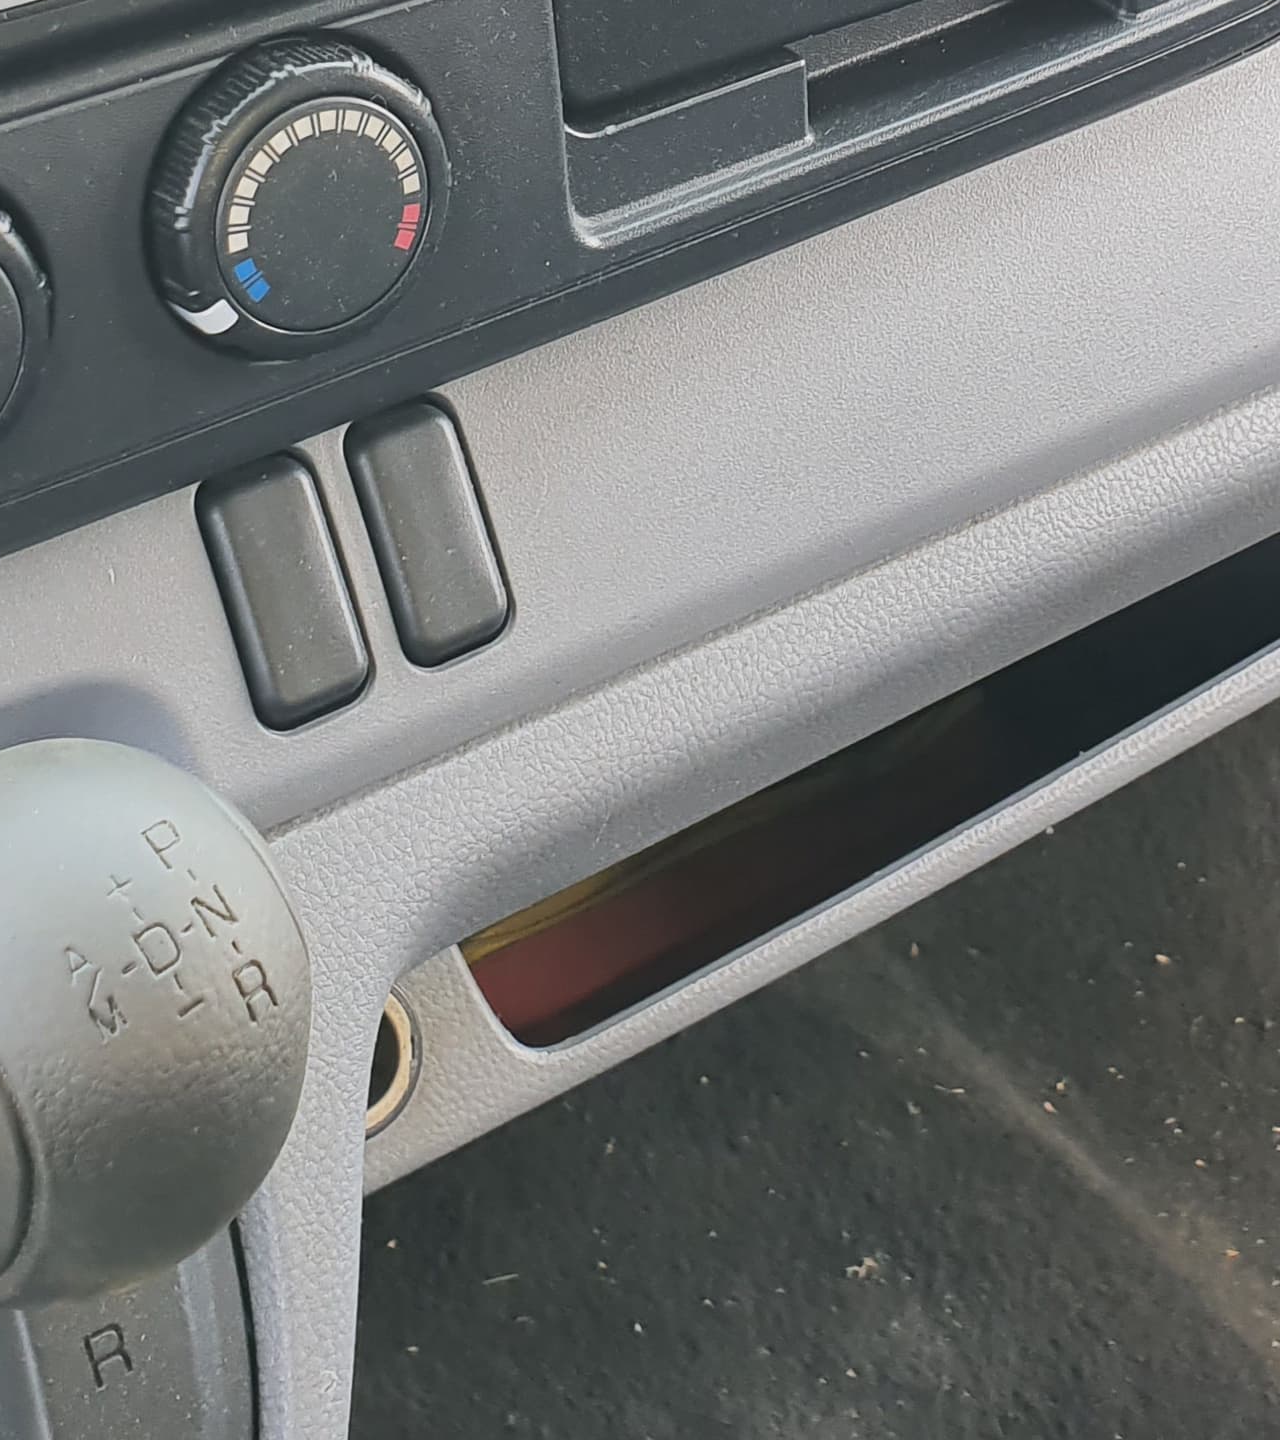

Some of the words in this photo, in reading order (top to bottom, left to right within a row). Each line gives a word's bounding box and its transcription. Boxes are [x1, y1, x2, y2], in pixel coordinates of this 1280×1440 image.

[141, 820, 181, 869] P
[190, 884, 238, 937] N
[133, 922, 181, 976] D
[232, 959, 279, 1023] R
[84, 1322, 134, 1393] R
